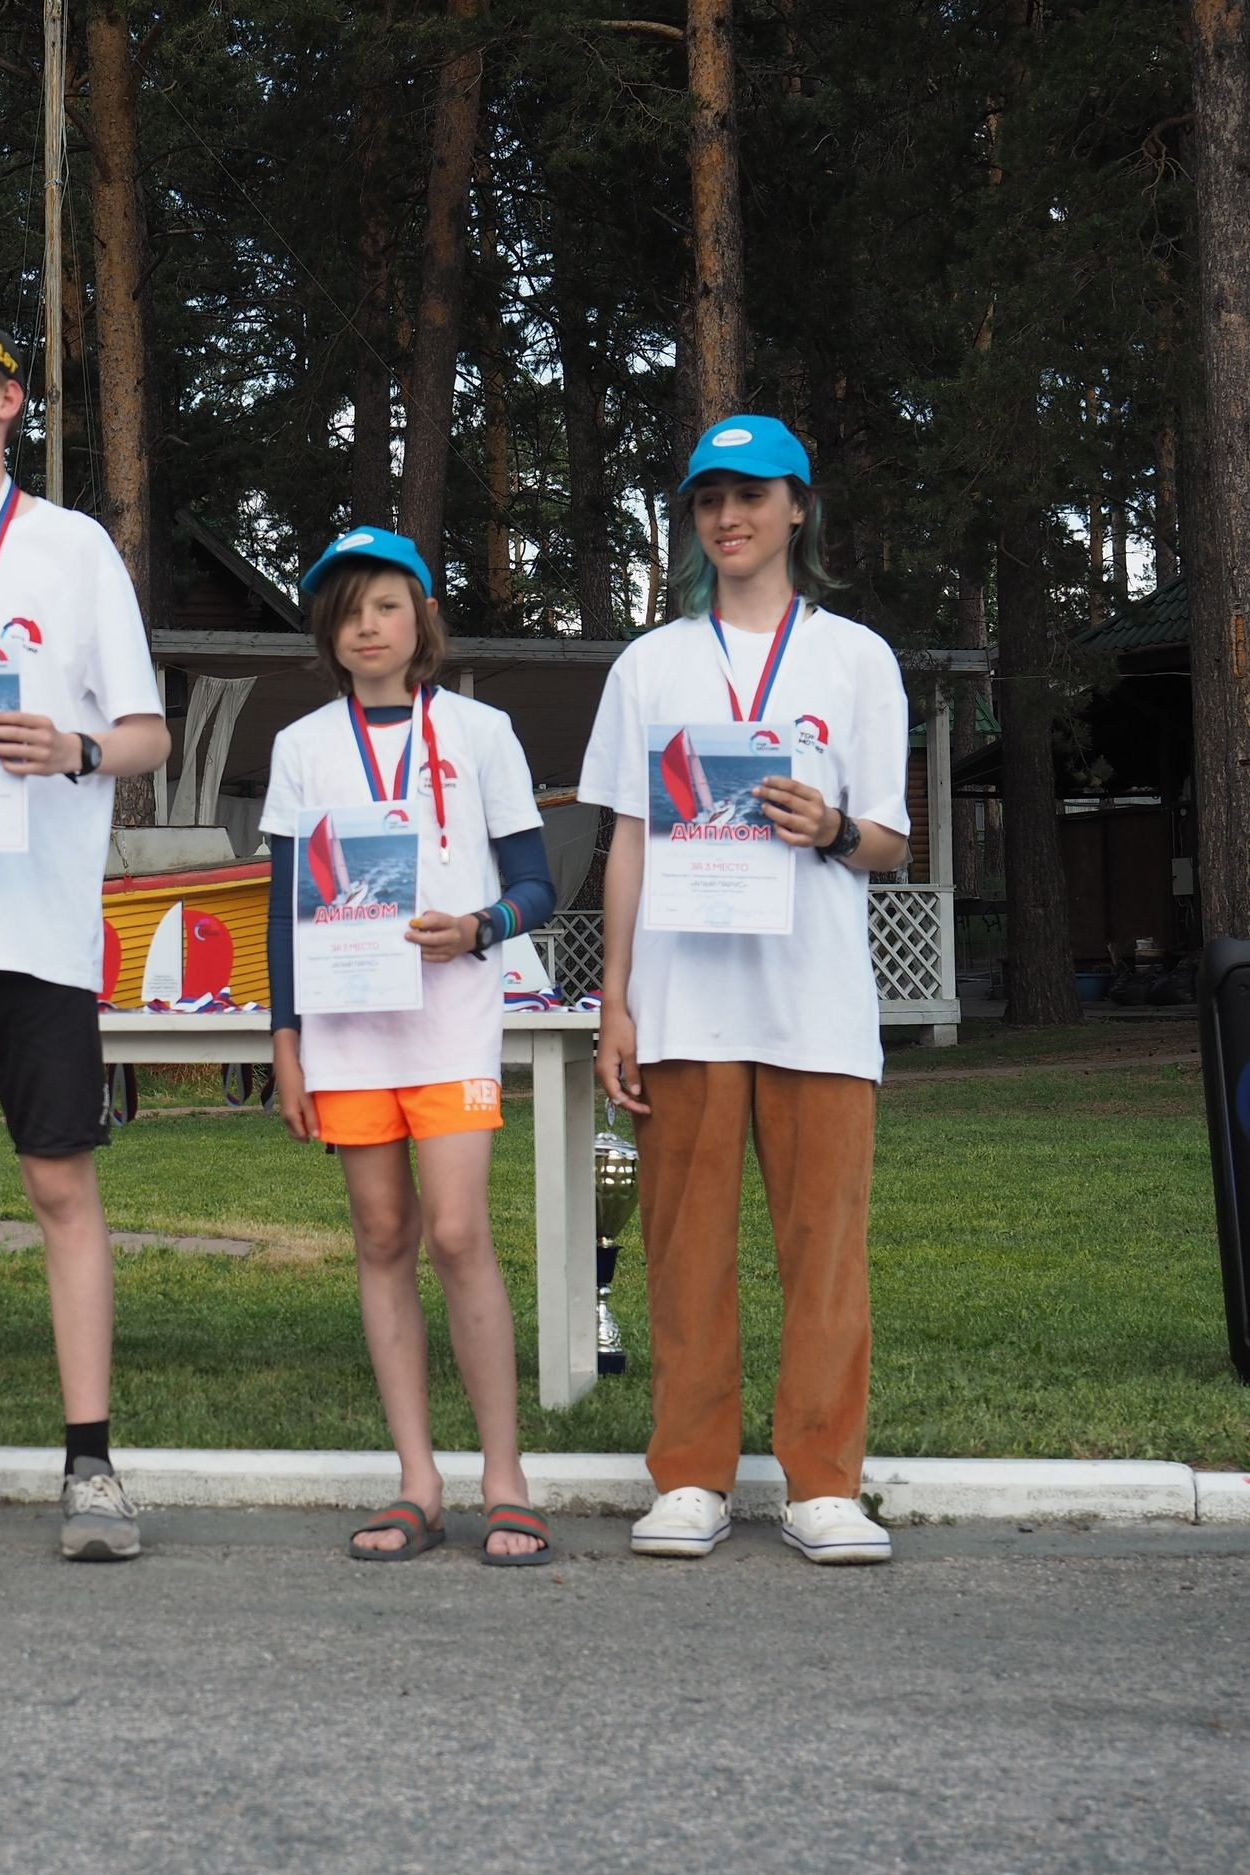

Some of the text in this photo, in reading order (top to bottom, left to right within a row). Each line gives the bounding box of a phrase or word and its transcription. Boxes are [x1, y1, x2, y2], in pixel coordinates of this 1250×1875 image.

[670, 824, 771, 841] ДИПЛОМ
[690, 862, 703, 870] ЗА
[713, 863, 749, 872] МЕСТО
[314, 902, 398, 924] ДИПЛОМ
